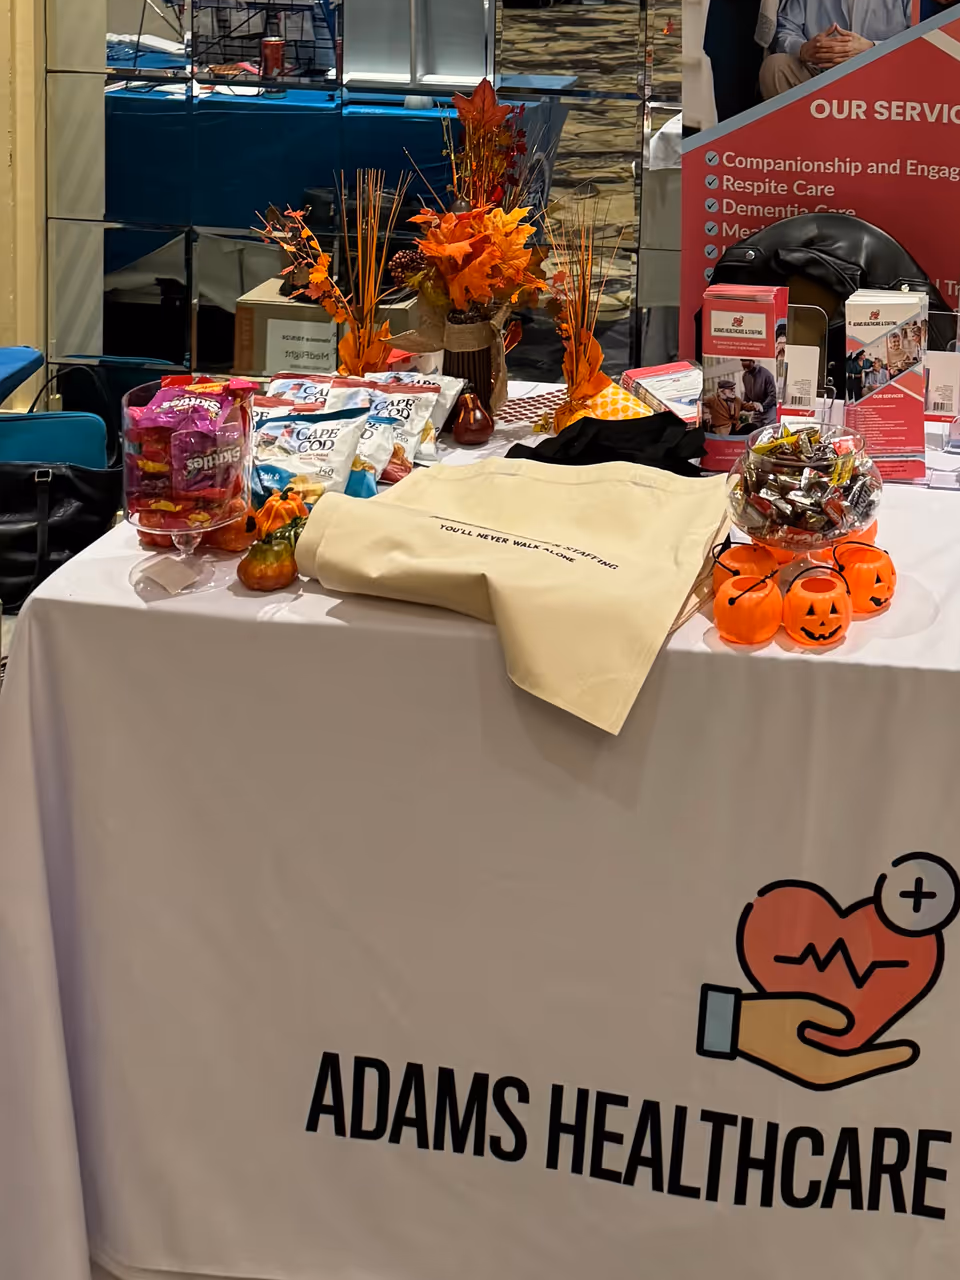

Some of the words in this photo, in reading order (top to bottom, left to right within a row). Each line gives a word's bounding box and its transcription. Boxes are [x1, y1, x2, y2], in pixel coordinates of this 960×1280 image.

[809, 98, 869, 123] OUR
[721, 151, 863, 177] Companionship
[867, 158, 900, 175] and
[721, 175, 788, 196] Respite
[793, 180, 836, 197] Care
[722, 198, 809, 218] Dementia
[162, 396, 222, 417] Skittles
[374, 398, 416, 411] CAPE
[296, 427, 340, 441] CAPE
[186, 446, 242, 471] Skittles
[440, 524, 474, 536] YOU'LL
[476, 532, 510, 544] NEVER
[512, 540, 540, 550] WALK
[542, 547, 576, 564] ALONE
[563, 546, 619, 570] STAFFING
[306, 1051, 530, 1162] ADAMS
[545, 1083, 953, 1220] HEALTHCARE
